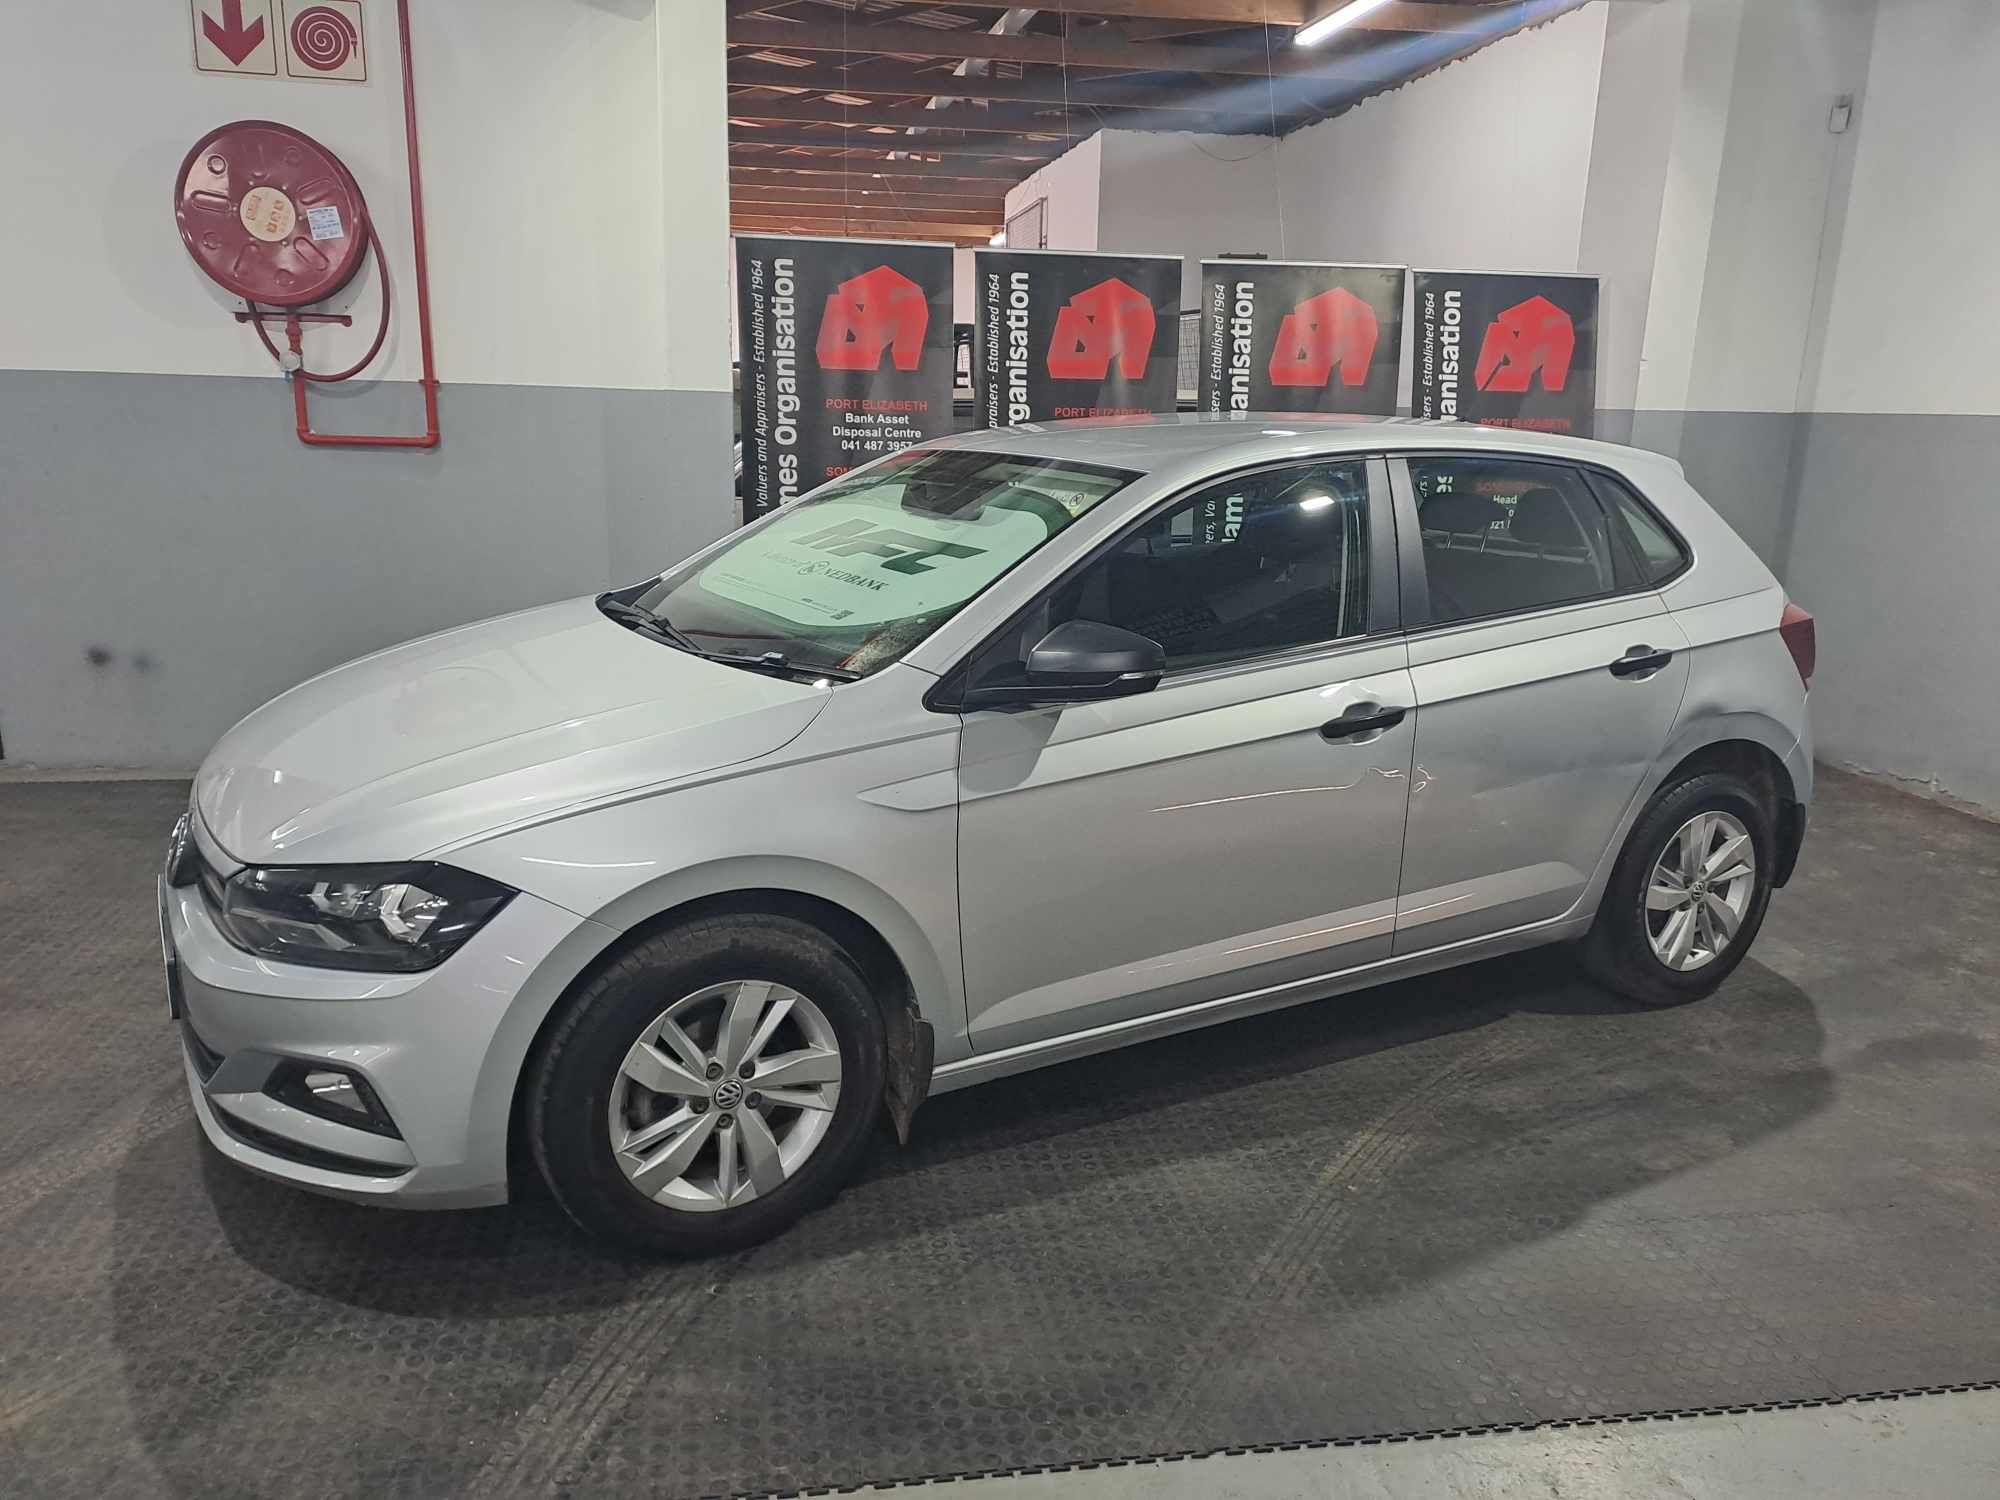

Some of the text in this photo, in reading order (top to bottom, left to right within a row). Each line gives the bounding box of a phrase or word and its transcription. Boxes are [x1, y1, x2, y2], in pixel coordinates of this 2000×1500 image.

[751, 259, 764, 290] 1964
[987, 273, 1000, 299] 1964
[1214, 283, 1226, 312] 1964
[1425, 292, 1436, 319] 1964
[752, 291, 765, 363] Established
[987, 301, 1000, 373] Established
[772, 258, 800, 446] Organisation
[1211, 313, 1225, 381] Established
[1229, 281, 1254, 411] anisation
[1422, 320, 1435, 387] Established
[753, 373, 769, 437] Appraisers
[825, 399, 928, 412] PORT ELIZABETH
[845, 412, 909, 425] Bank Asset
[1054, 407, 1086, 417] PORT
[832, 425, 922, 439] Disposal Centre
[841, 440, 860, 450] 041
[864, 440, 883, 450] 487
[756, 439, 768, 462] and
[756, 464, 768, 507] Valuers
[823, 567, 889, 592] NEDBANK
